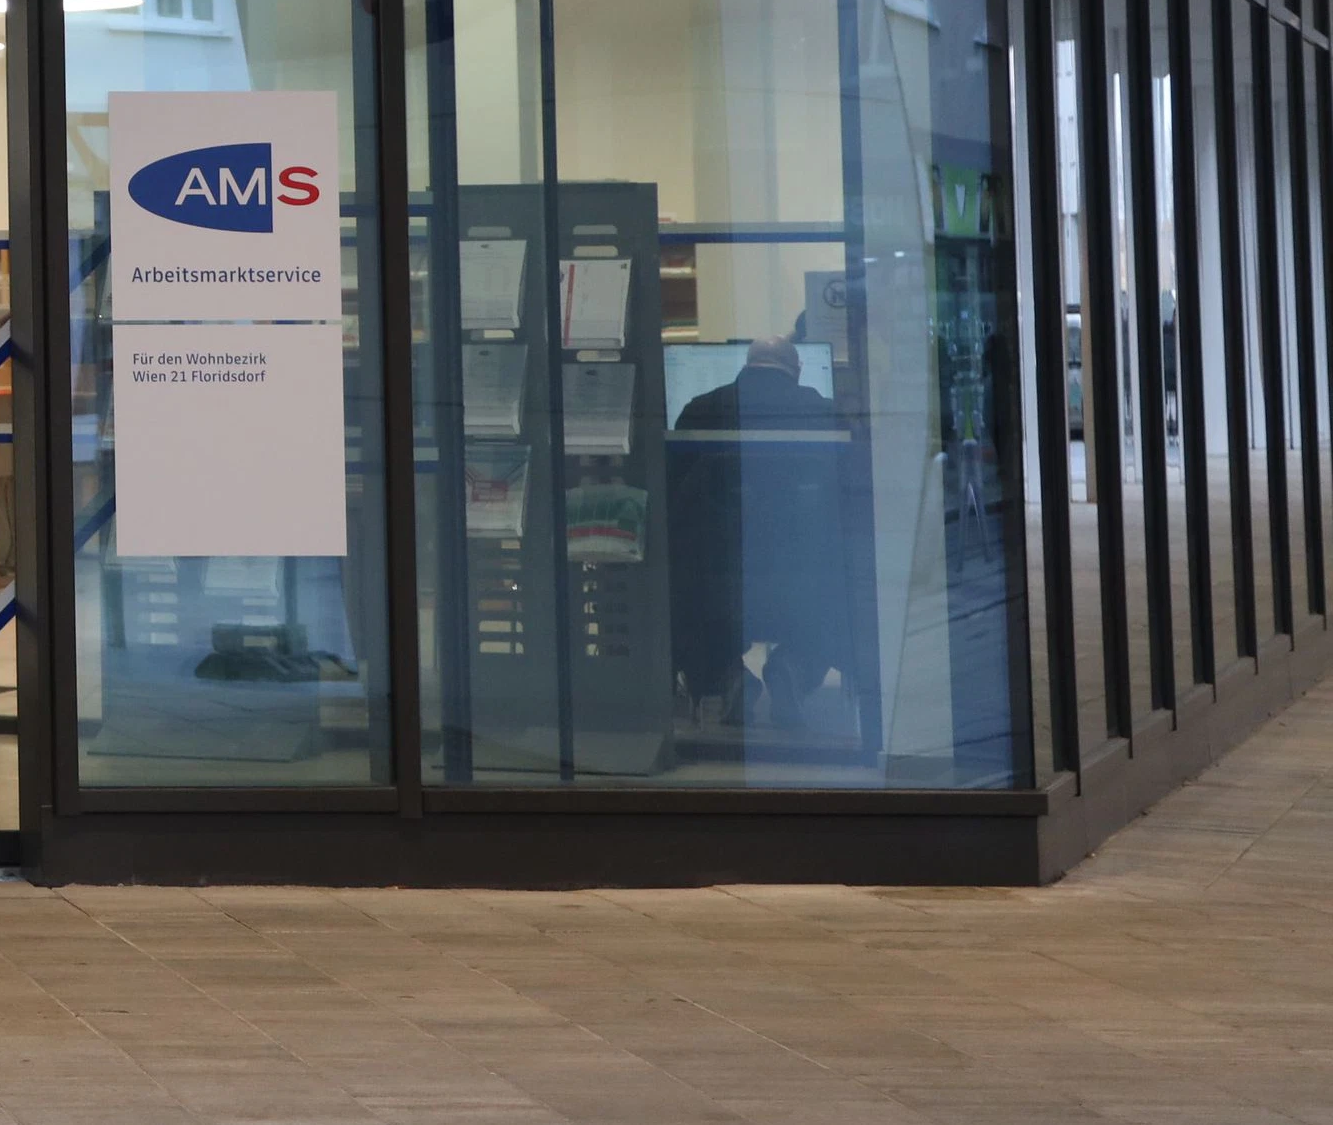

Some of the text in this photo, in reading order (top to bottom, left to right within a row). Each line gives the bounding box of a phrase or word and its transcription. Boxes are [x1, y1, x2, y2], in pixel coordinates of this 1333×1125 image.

[174, 166, 320, 206] AMS
[132, 266, 321, 283] Arbeitsmarktservice
[132, 352, 266, 365] Für den Wohnbezirk
[132, 370, 266, 383] Wien 21 Floridsdorf
